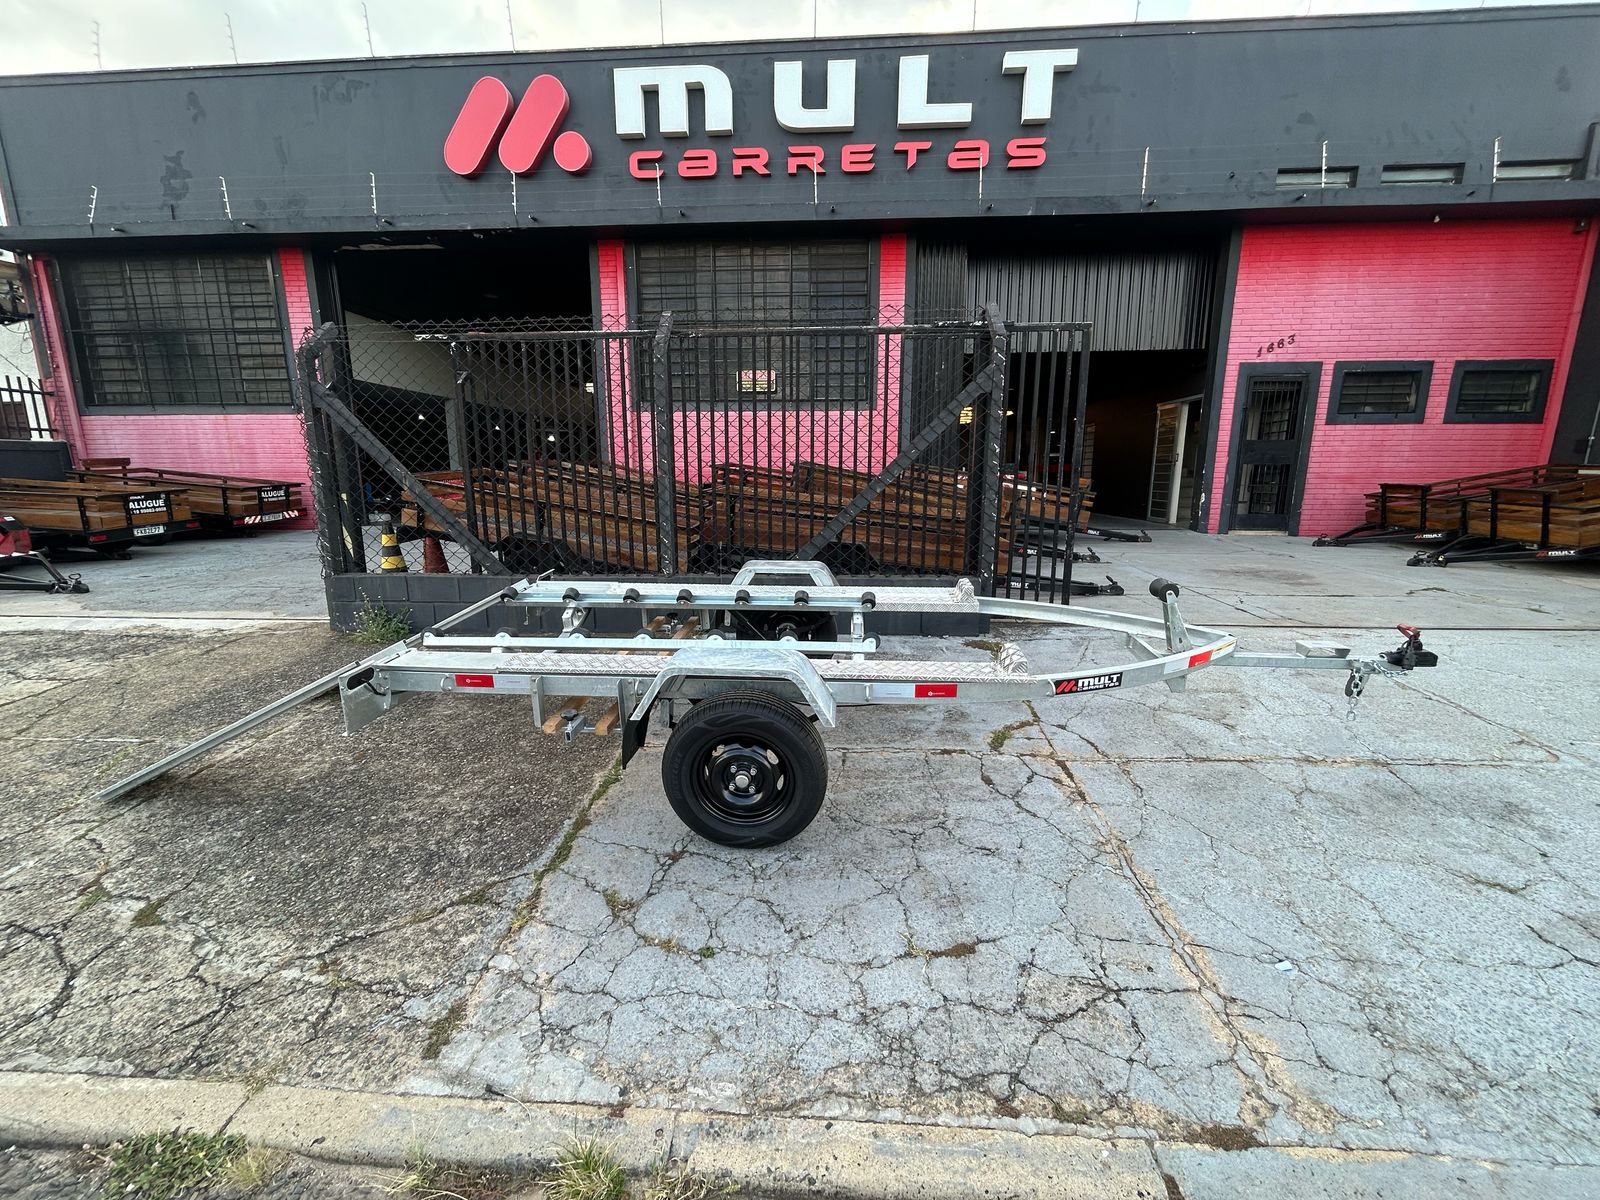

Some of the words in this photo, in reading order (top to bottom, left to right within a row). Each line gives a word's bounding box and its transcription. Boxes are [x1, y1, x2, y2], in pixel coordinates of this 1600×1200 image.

[613, 48, 1078, 138] MULT
[629, 137, 1047, 179] CARRETAS
[1257, 333, 1296, 357] 1663
[129, 499, 166, 509] ALUGUE
[1078, 674, 1120, 687] MULT
